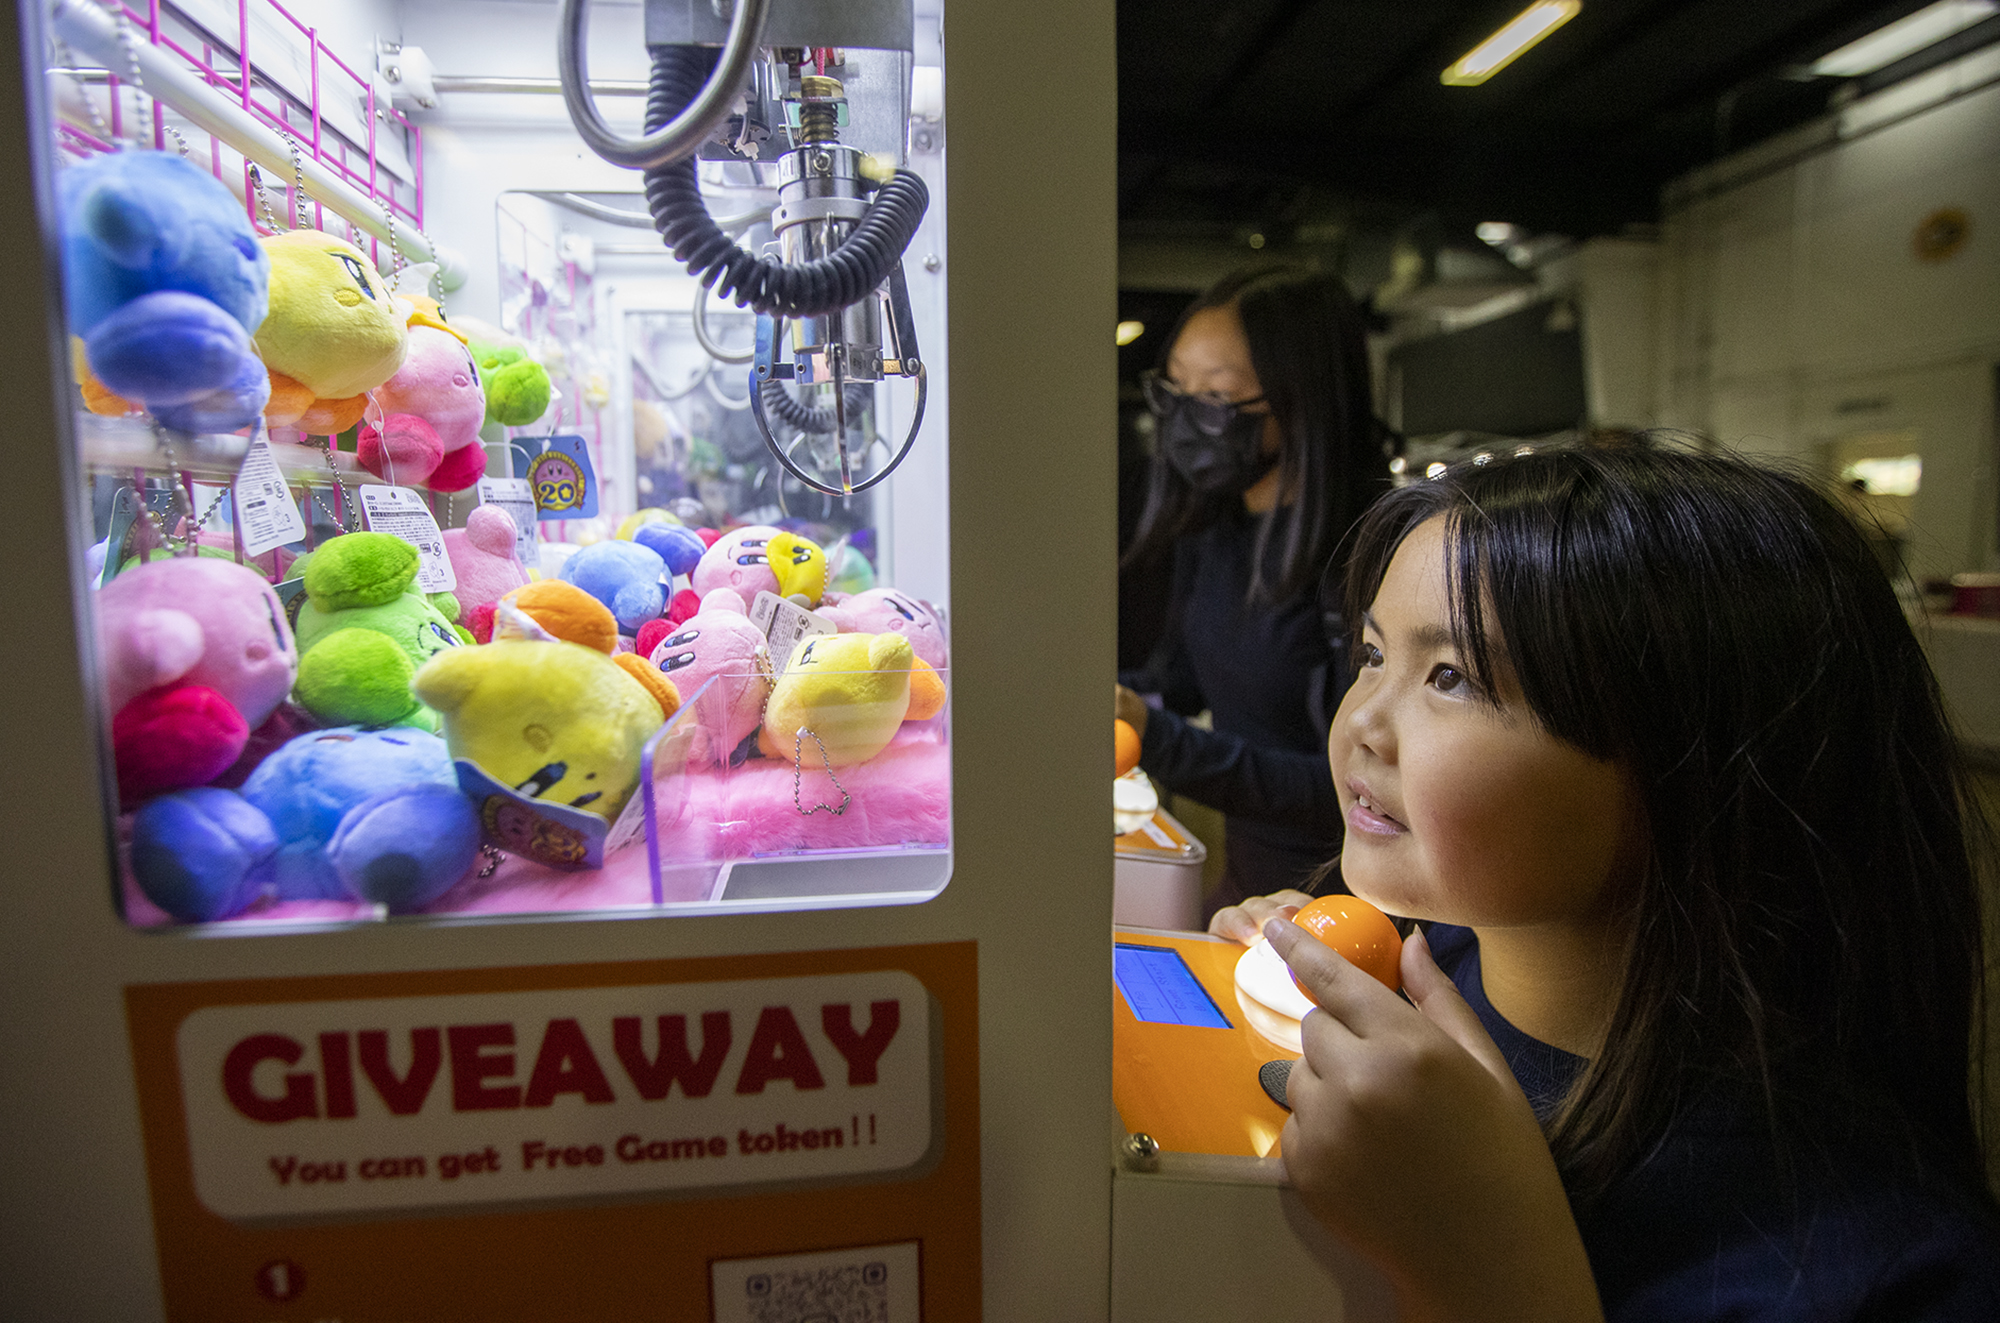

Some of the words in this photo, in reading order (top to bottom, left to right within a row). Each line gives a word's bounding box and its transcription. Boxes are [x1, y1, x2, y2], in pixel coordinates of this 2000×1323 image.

[539, 482, 576, 505] 20
[223, 1000, 900, 1123] GIVEAWAY
[269, 1156, 347, 1185] You
[359, 1156, 426, 1181] can
[438, 1147, 500, 1180] get
[521, 1141, 604, 1170] Free
[616, 1134, 727, 1164] Game
[267, 1263, 289, 1297] 1
